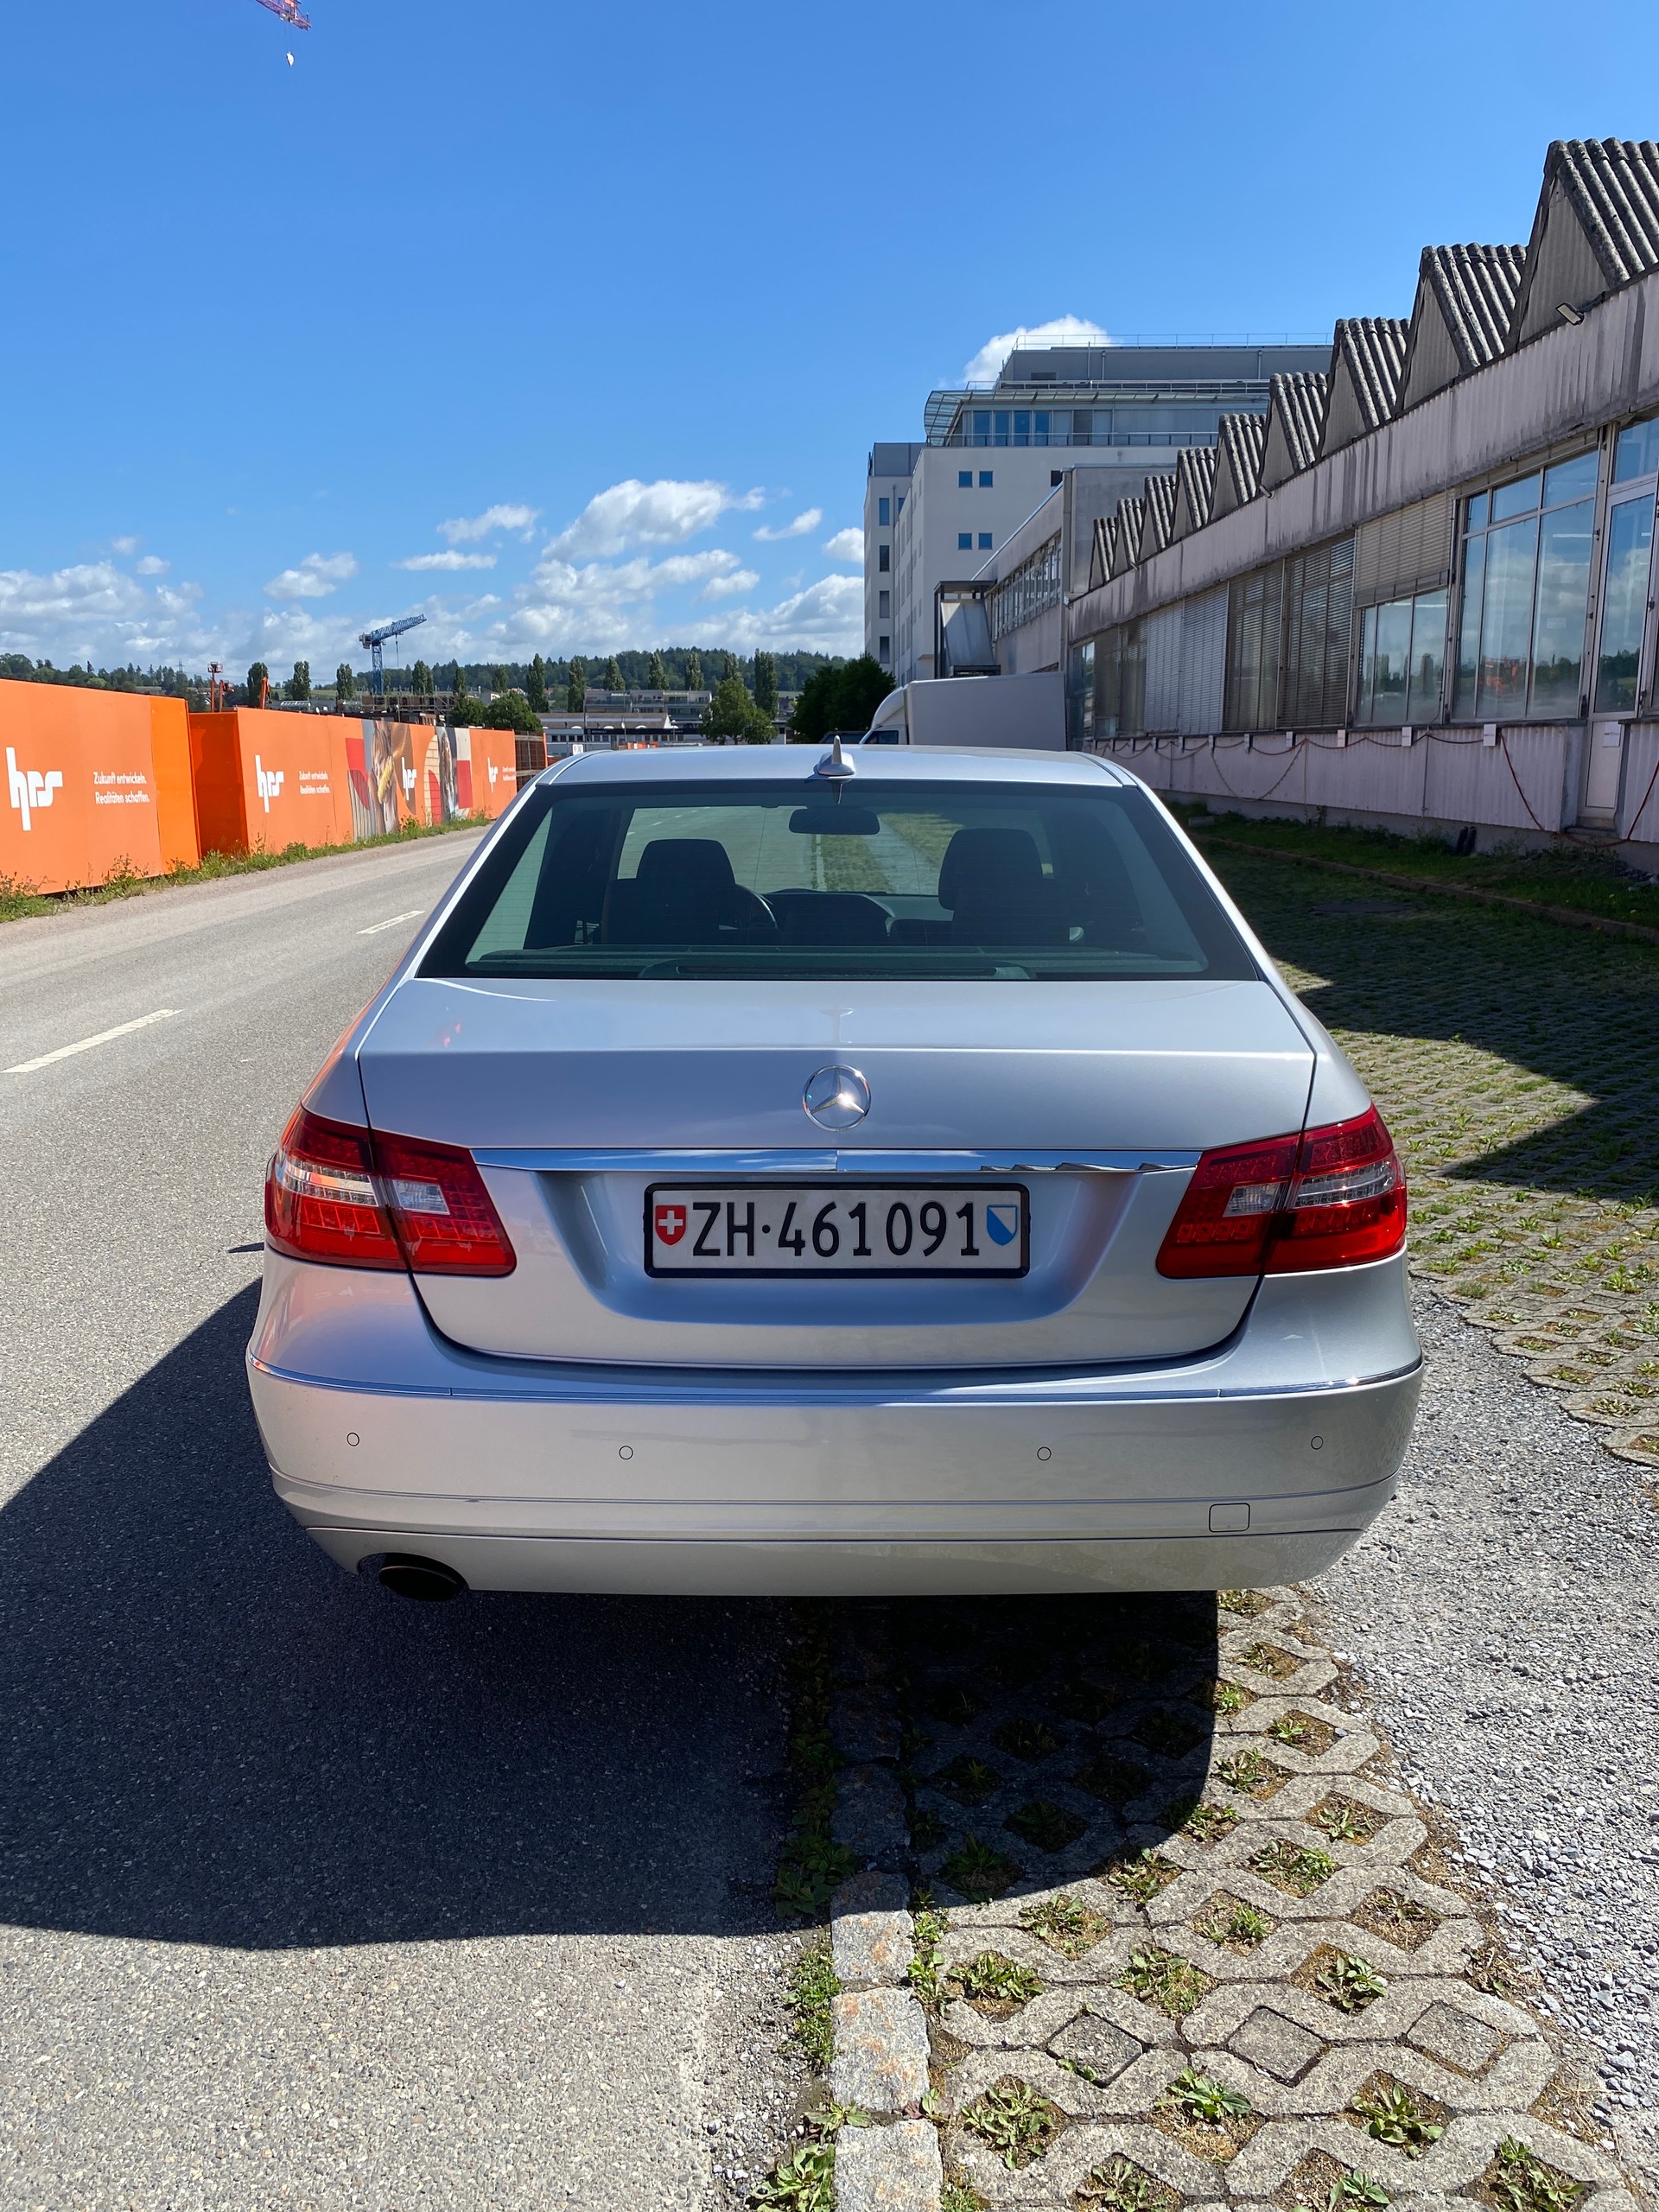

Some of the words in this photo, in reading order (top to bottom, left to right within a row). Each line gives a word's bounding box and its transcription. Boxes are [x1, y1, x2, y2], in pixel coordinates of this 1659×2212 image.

[6, 747, 63, 831] hrs
[92, 771, 116, 785] Zukunft
[116, 771, 147, 785] entwickeln.
[255, 754, 284, 813] hrs
[95, 791, 124, 804] Realitäten
[124, 790, 150, 804] schaffen.
